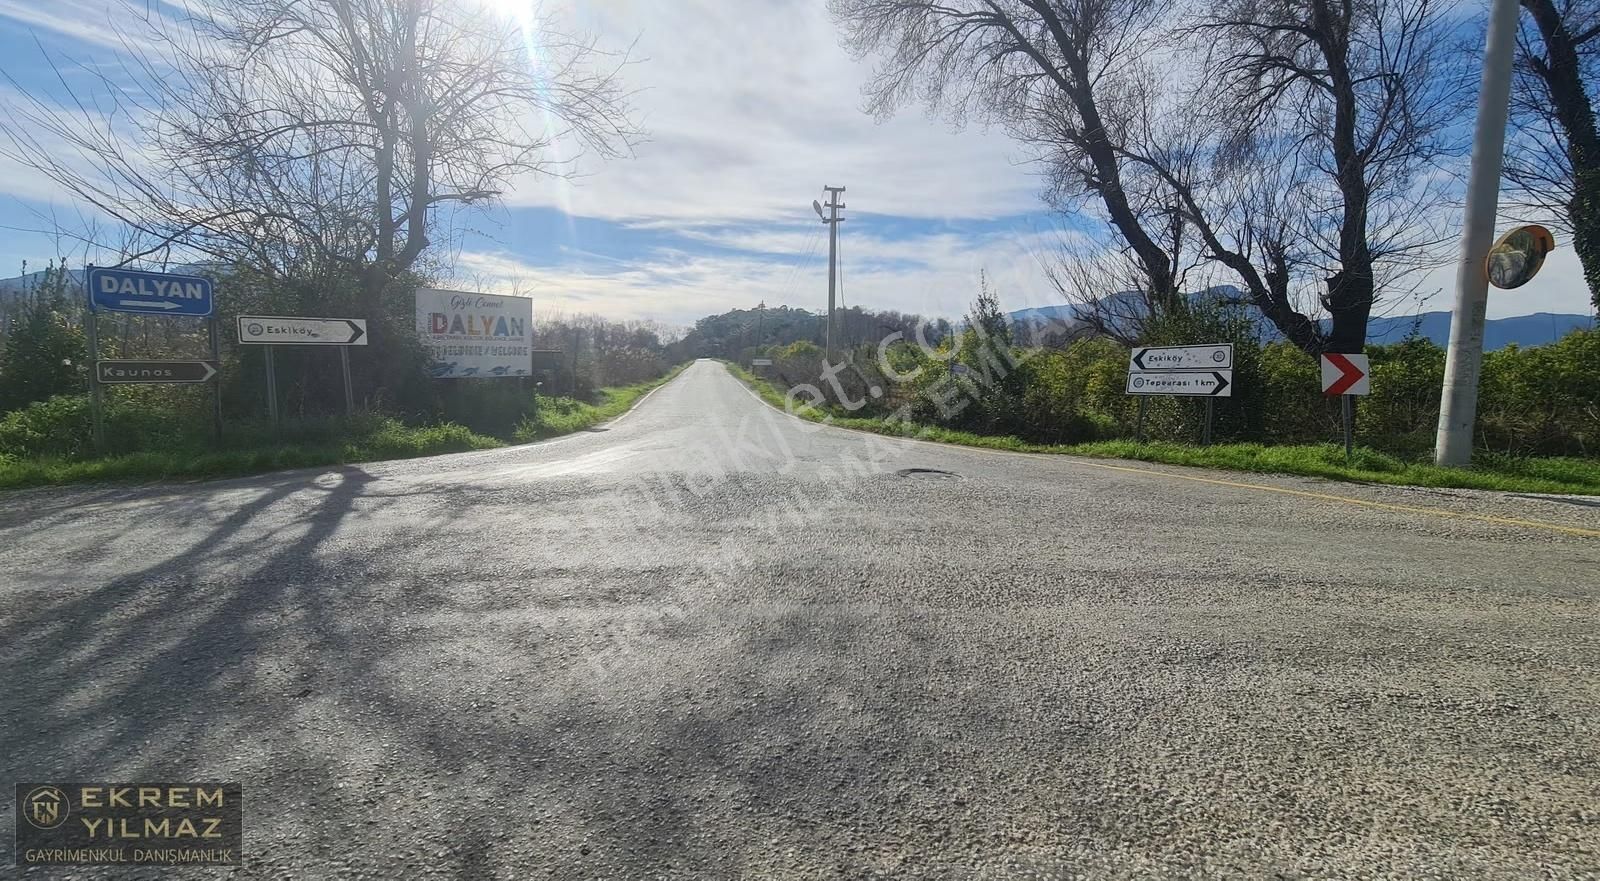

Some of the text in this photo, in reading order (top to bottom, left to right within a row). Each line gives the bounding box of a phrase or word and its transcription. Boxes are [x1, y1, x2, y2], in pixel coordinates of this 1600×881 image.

[100, 276, 203, 299] DALYAN
[432, 312, 525, 337] DALYAN
[266, 326, 313, 337] Eskiköy
[1148, 355, 1183, 363] Eskiköy
[104, 367, 173, 377] Kaunos
[1200, 379, 1216, 387] km
